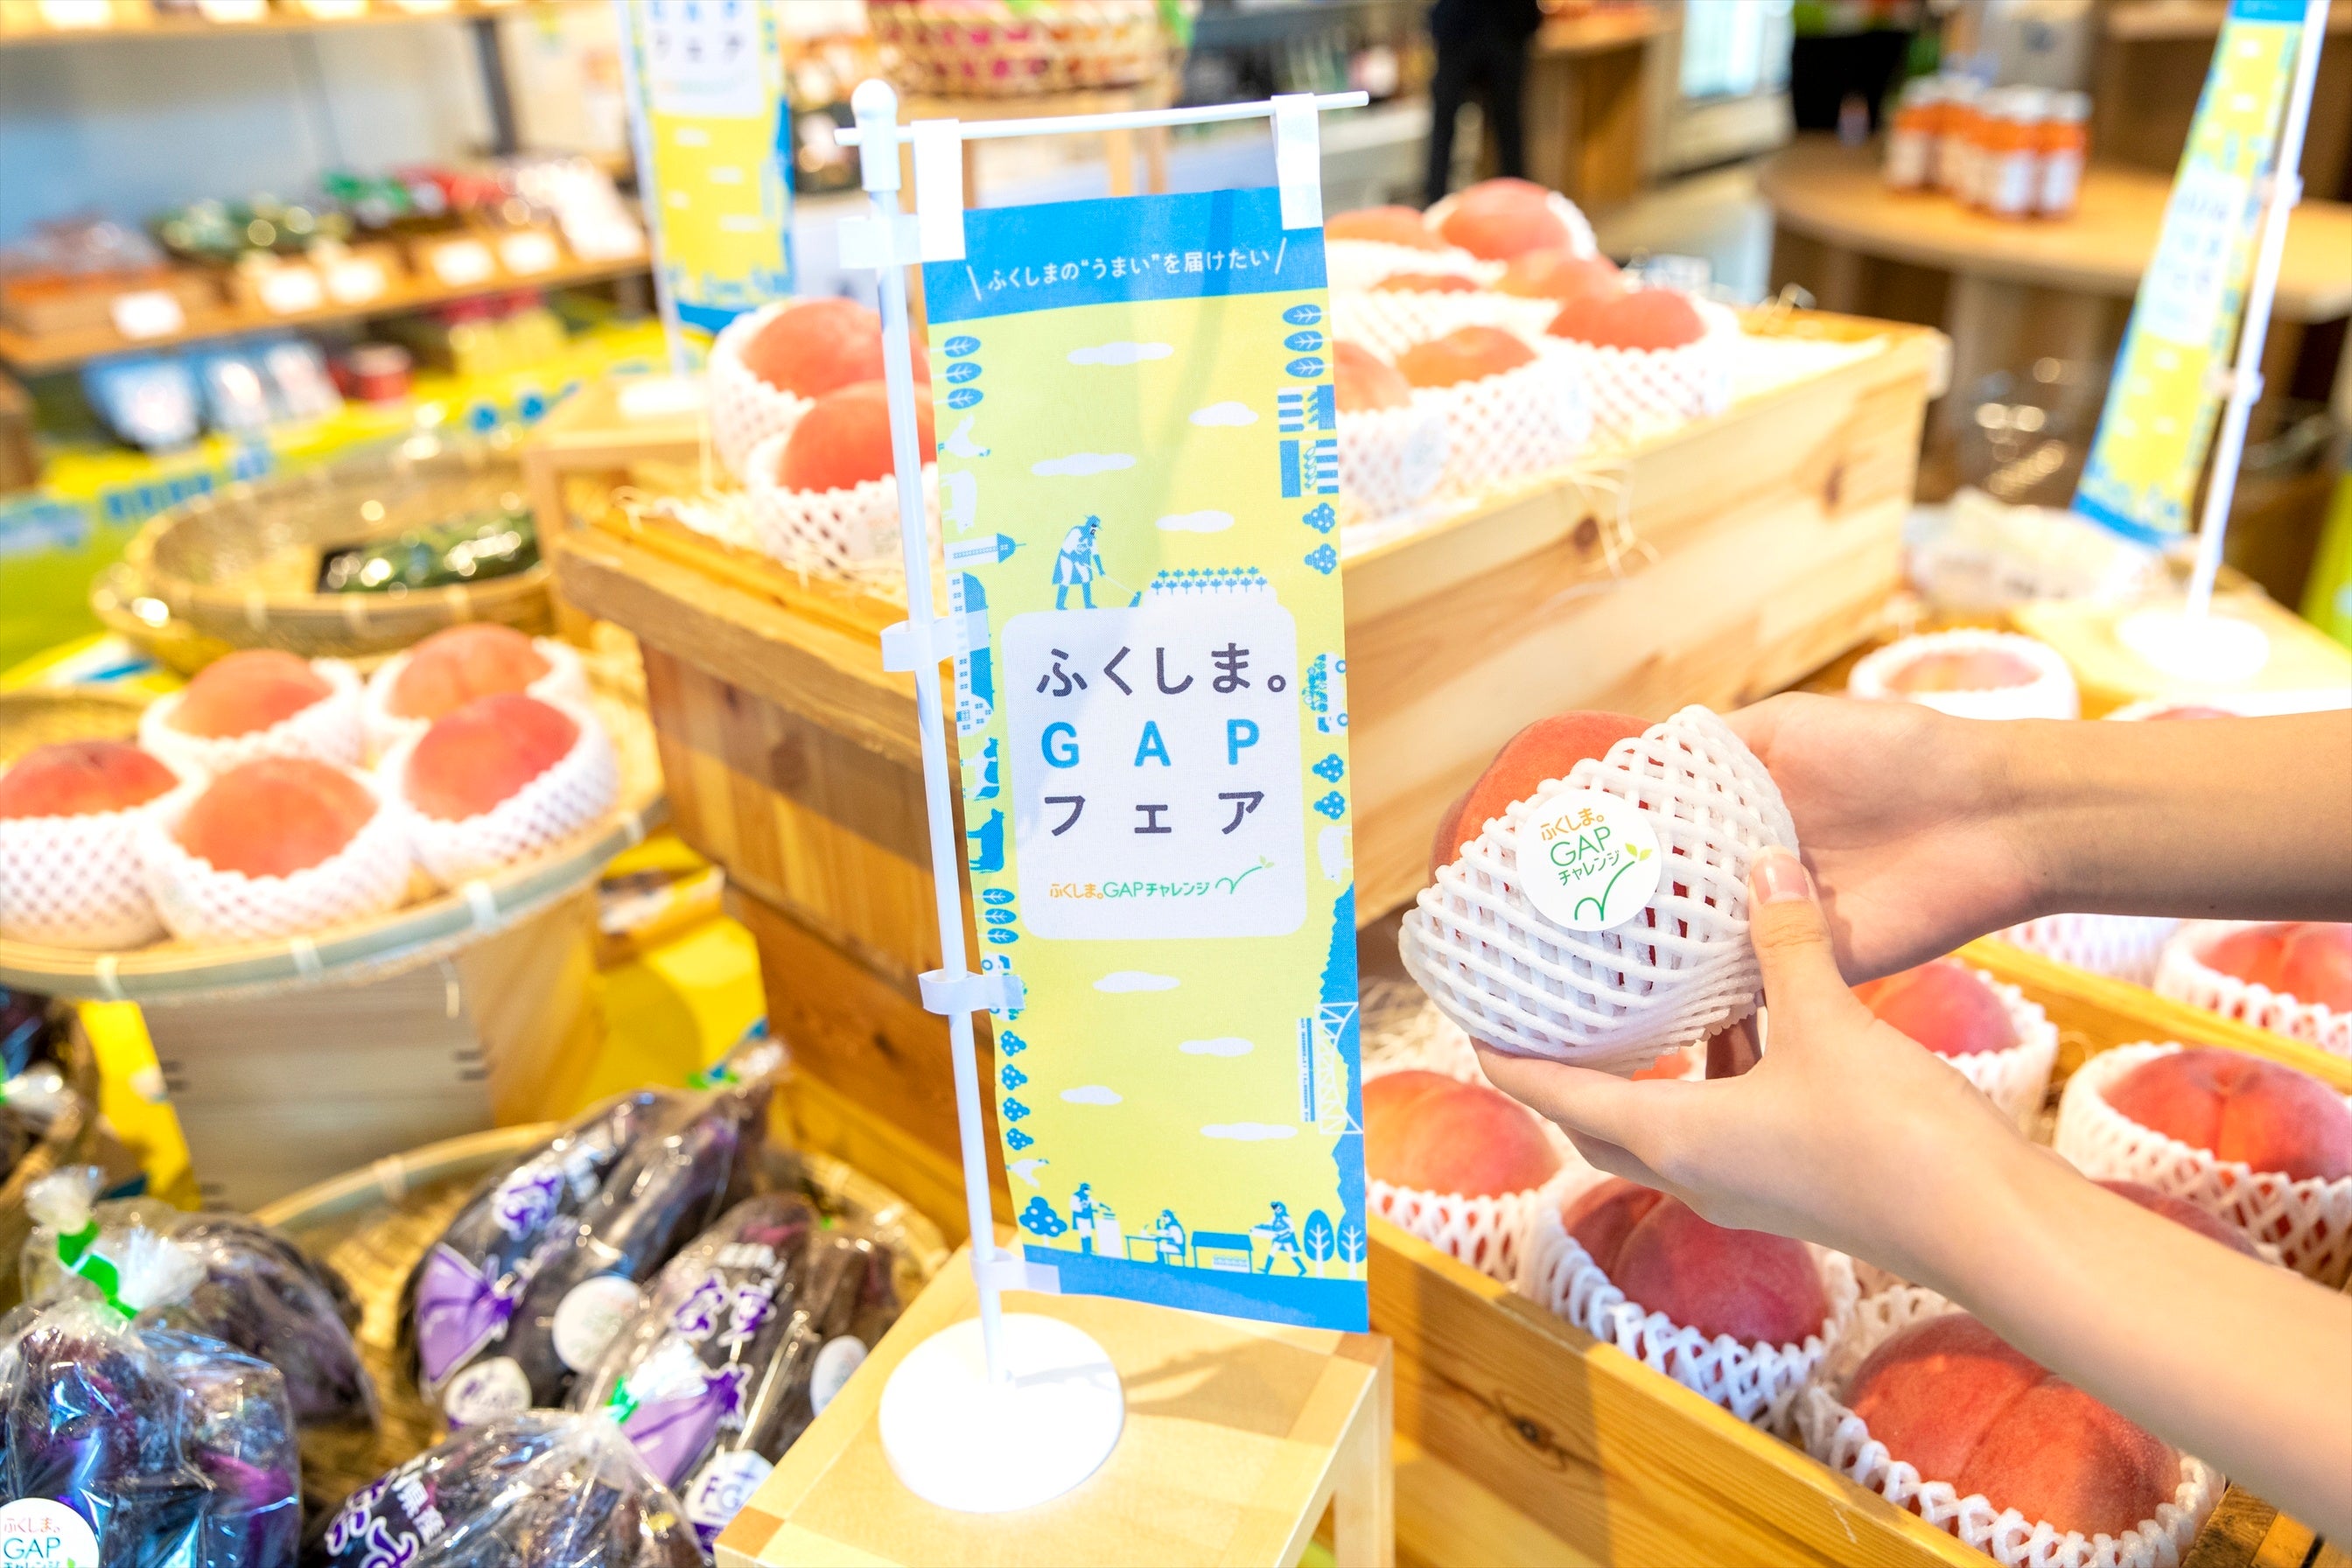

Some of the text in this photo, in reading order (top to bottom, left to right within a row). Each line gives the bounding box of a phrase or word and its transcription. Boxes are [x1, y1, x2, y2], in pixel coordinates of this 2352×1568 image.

[1036, 642, 1287, 697] ふくしま。
[1044, 790, 1265, 836] フェア
[1540, 807, 1606, 842] ふくしま。
[1550, 825, 1612, 867] GAP
[1558, 850, 1620, 886] チャレンジ
[4, 1516, 61, 1534] ふくしま。
[4, 1536, 61, 1560] GAP
